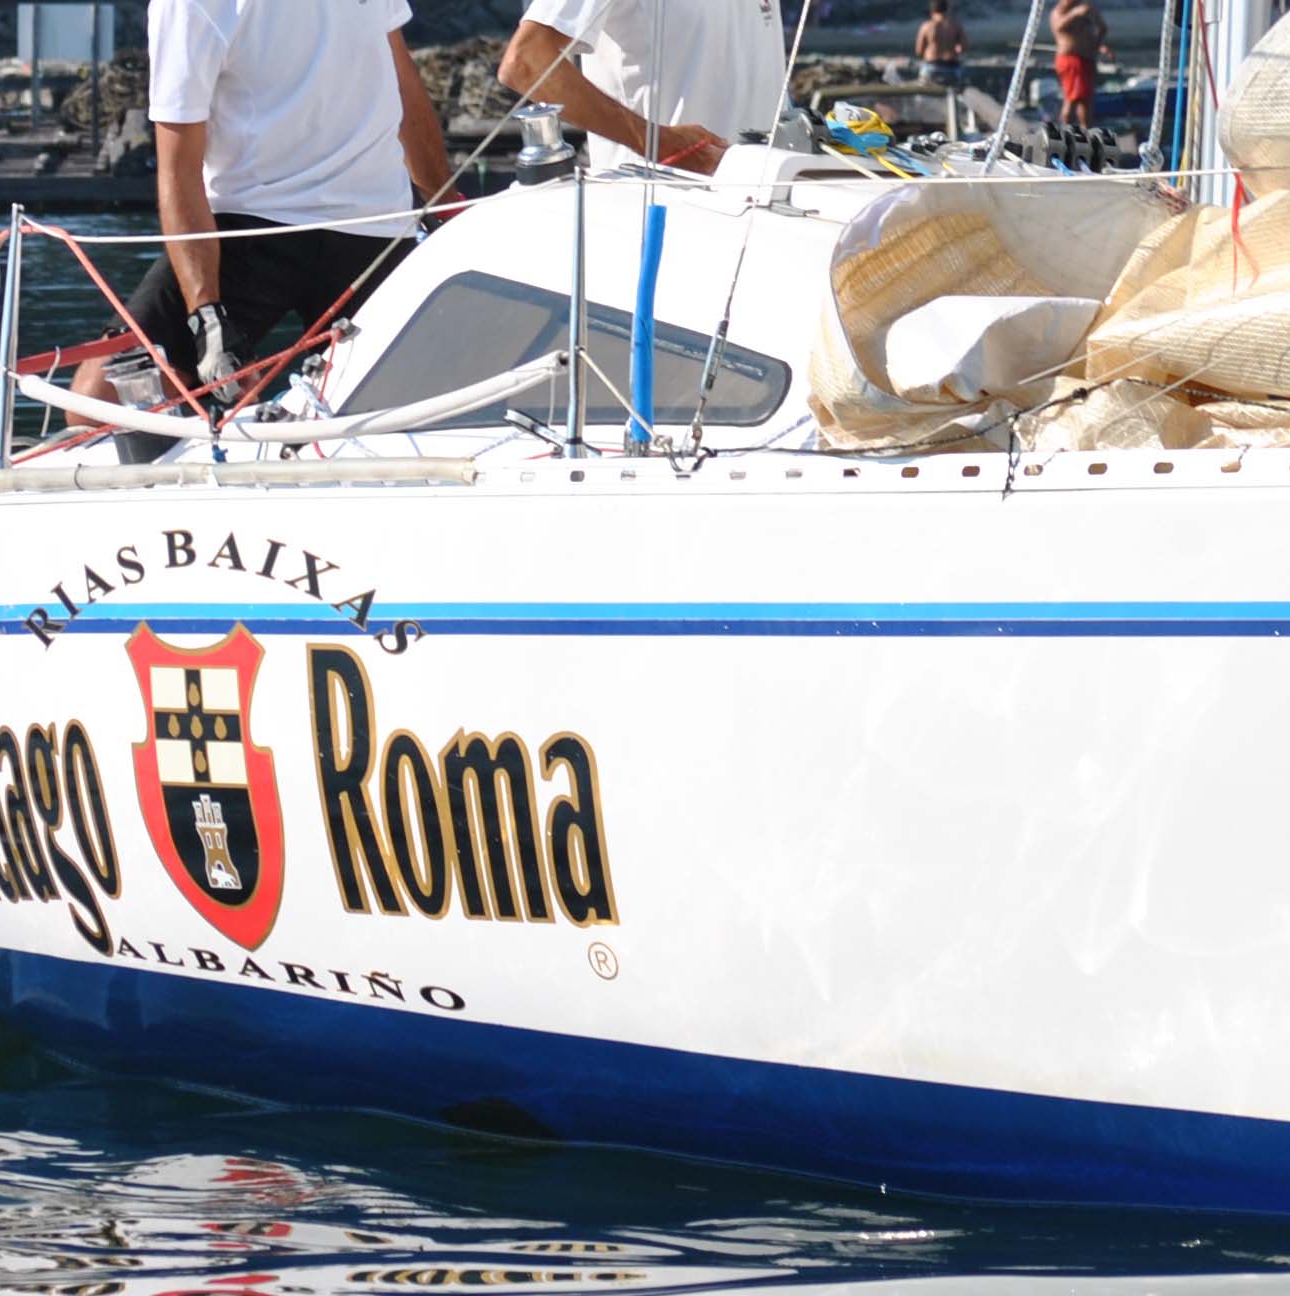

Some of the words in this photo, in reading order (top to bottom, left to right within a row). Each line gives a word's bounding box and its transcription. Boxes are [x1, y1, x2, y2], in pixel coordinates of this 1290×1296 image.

[24, 546, 146, 650] RIAS
[165, 530, 426, 655] BAIXAS
[306, 643, 621, 927] Roma
[118, 937, 466, 1011] ALBARIÑO
